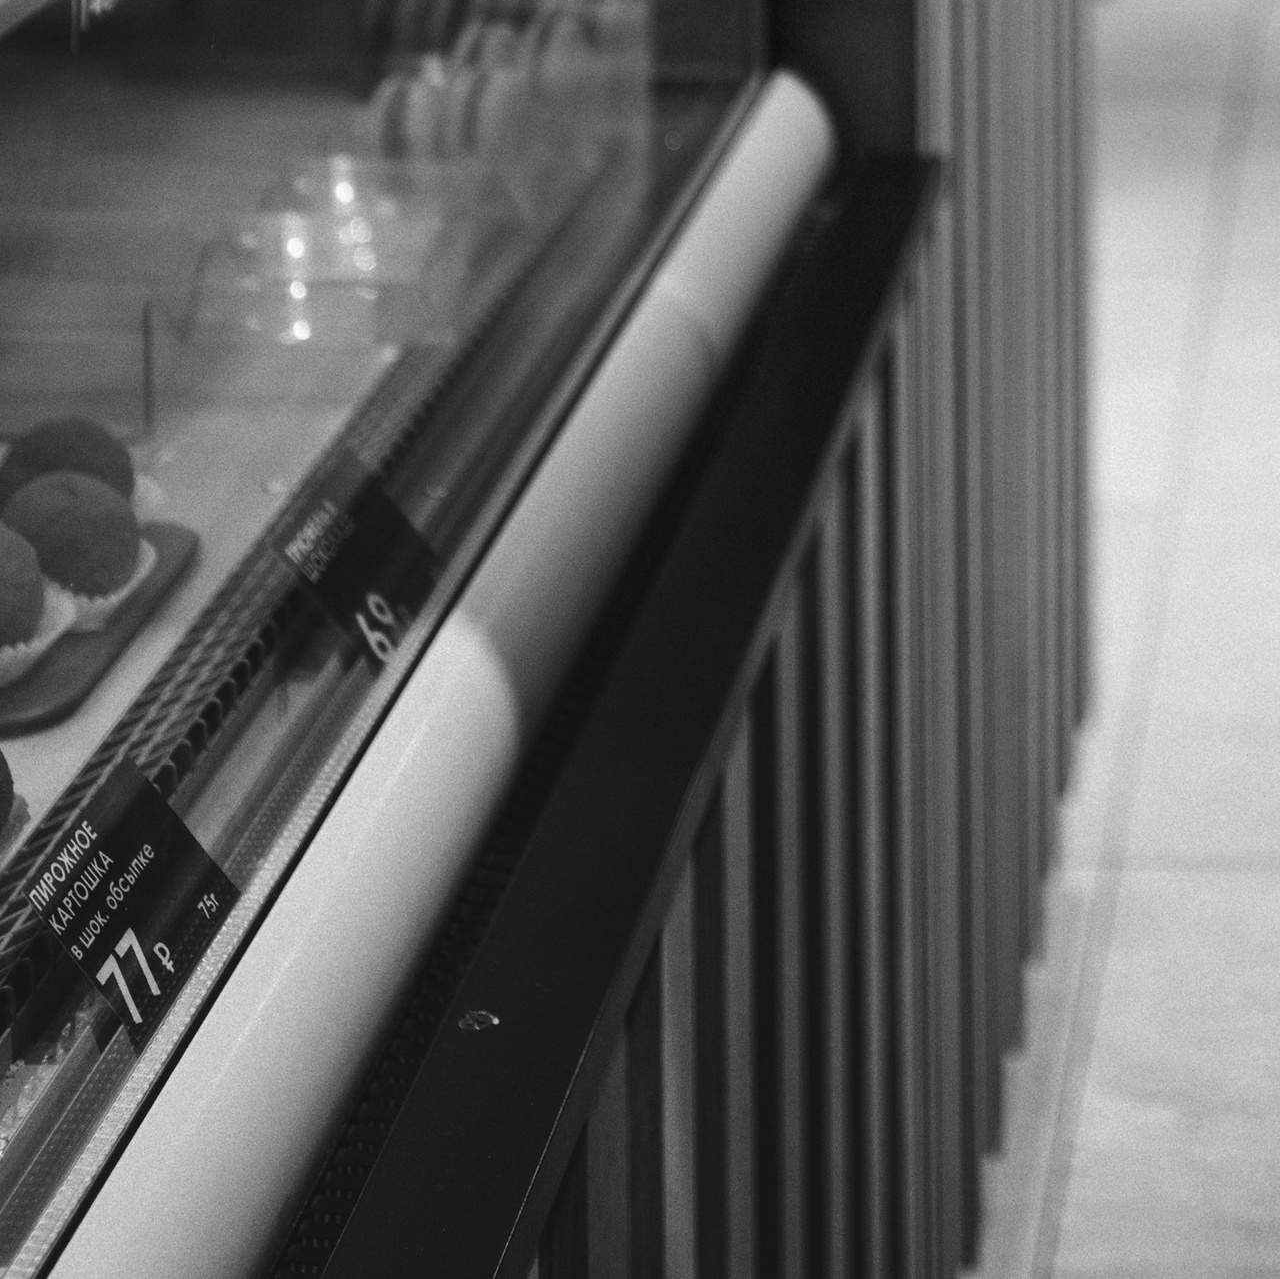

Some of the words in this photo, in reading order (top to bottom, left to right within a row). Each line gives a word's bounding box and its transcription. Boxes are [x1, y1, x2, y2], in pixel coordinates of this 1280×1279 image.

[30, 820, 98, 911] ПИРОЖНОЕ
[49, 851, 114, 935] КАРТОШКА
[81, 909, 110, 948] шок.
[107, 844, 155, 910] обсыпке
[197, 893, 219, 919] 75г
